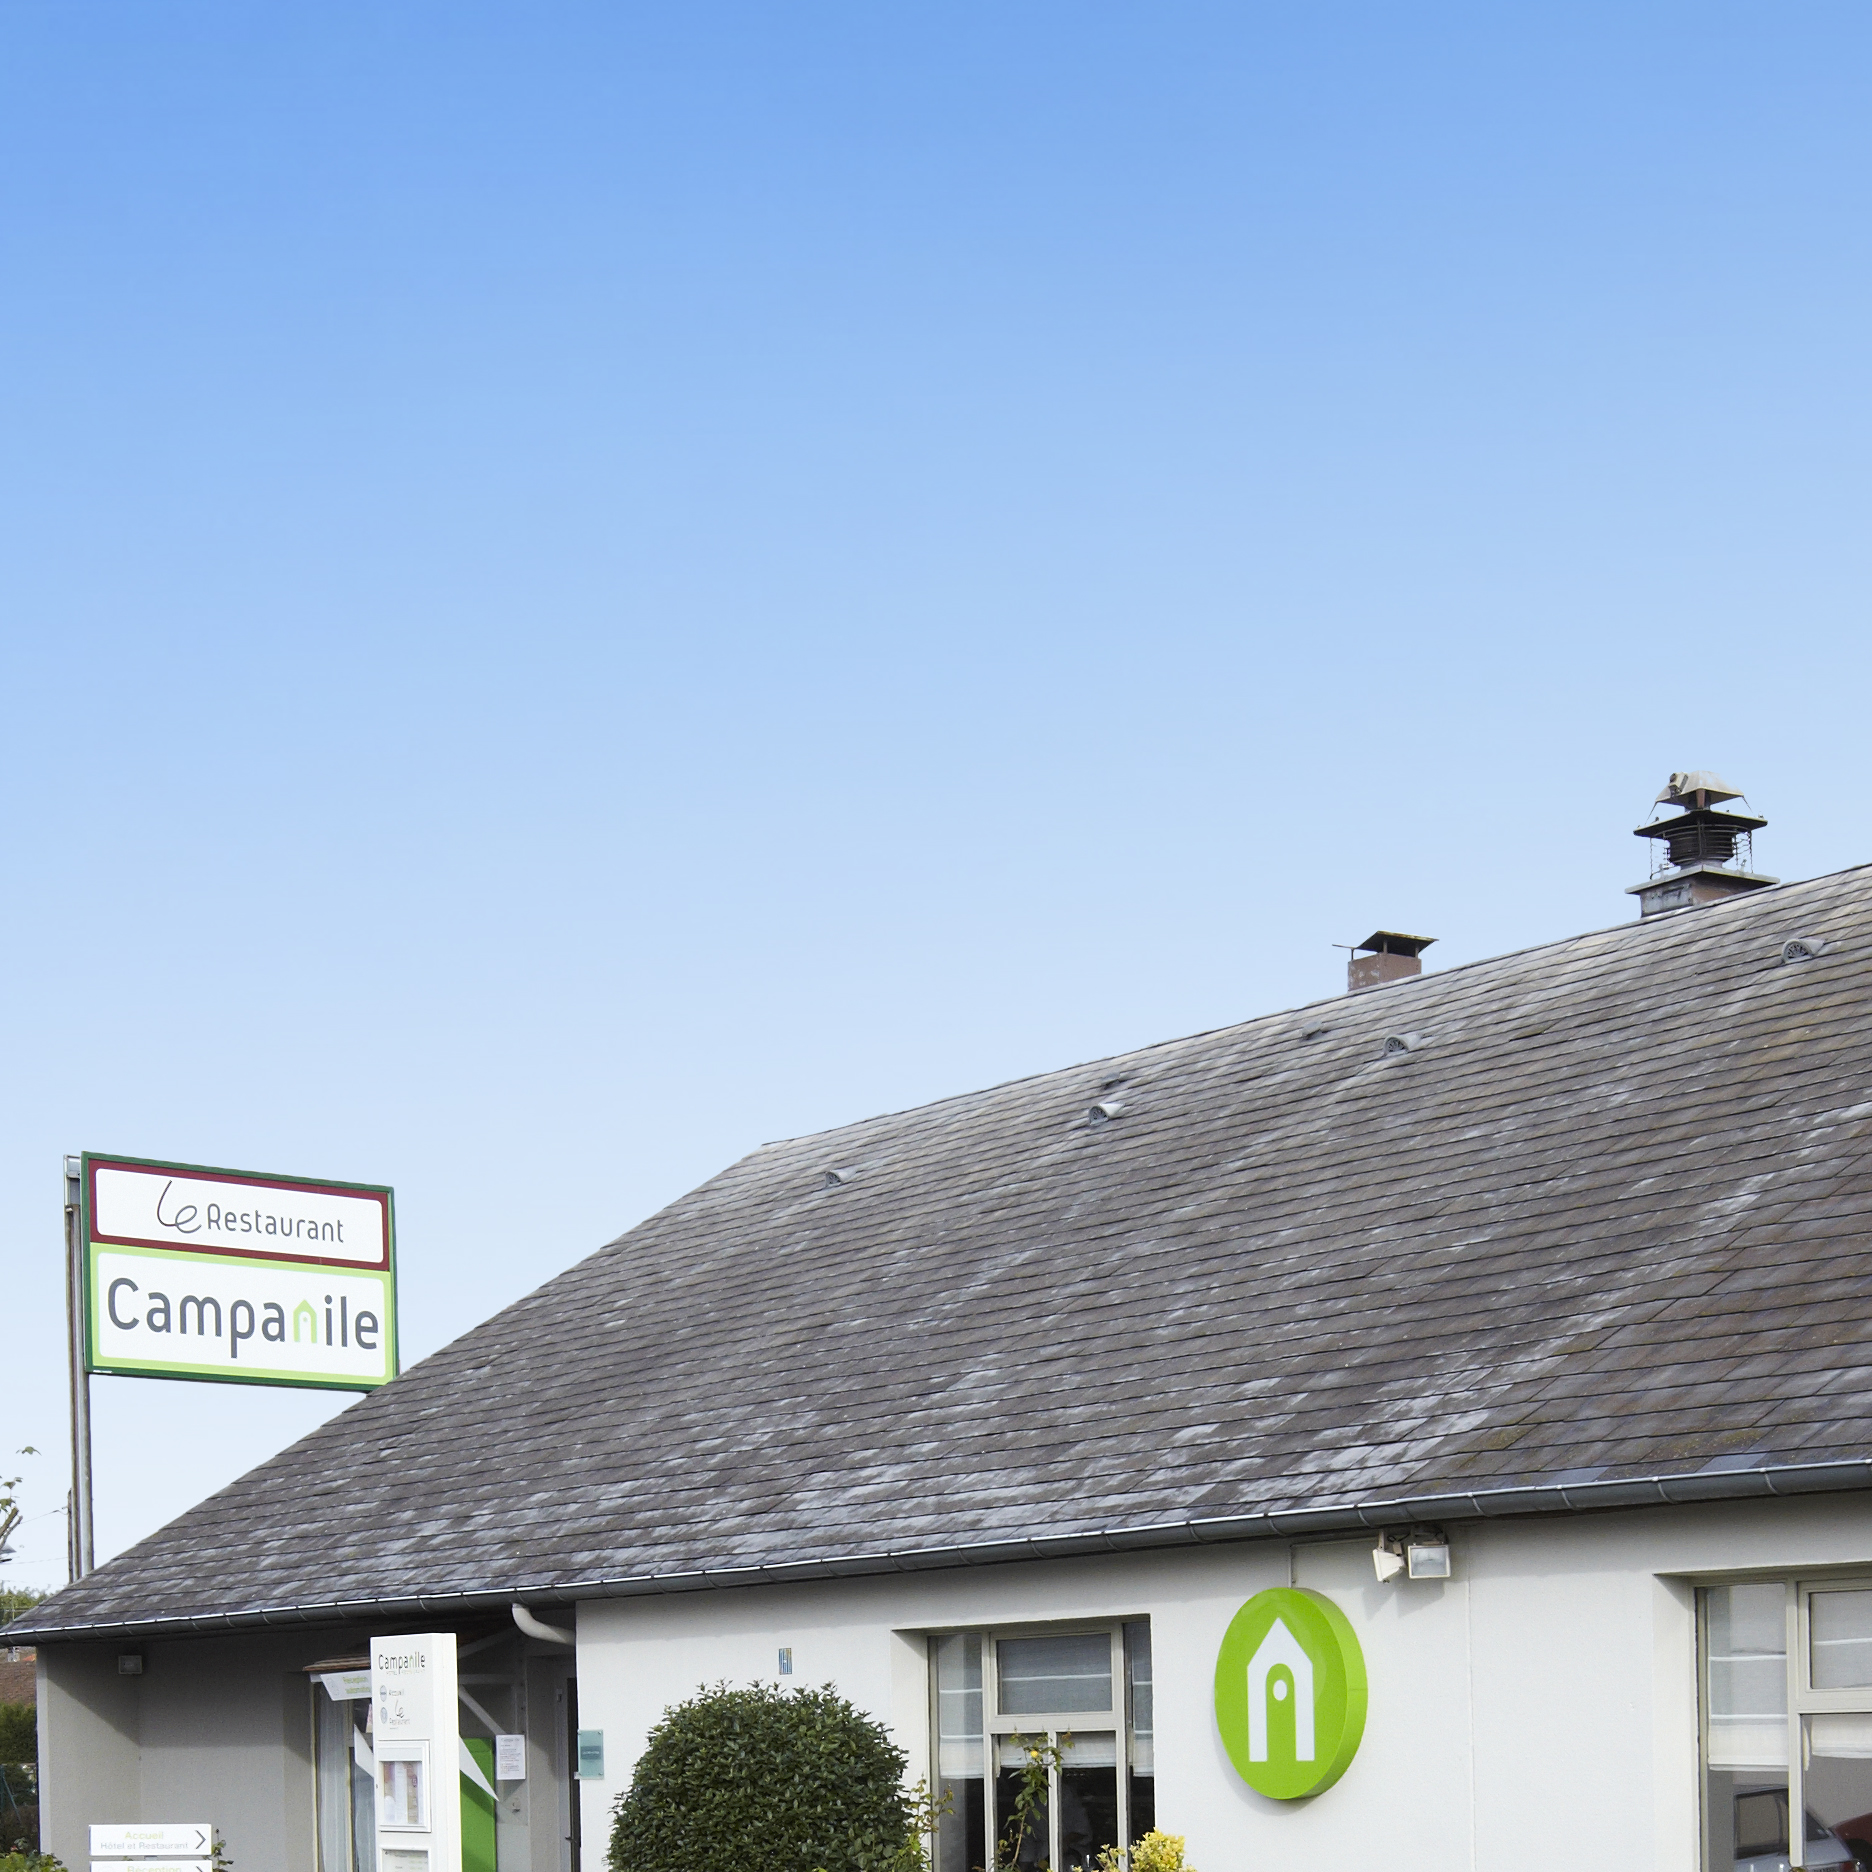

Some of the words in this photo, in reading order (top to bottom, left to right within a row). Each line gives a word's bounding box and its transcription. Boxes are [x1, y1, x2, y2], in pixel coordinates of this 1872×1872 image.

[156, 1179, 202, 1234] Le
[206, 1202, 345, 1244] Restaurant
[107, 1276, 380, 1359] Campanile
[378, 1651, 426, 1675] Campanile
[100, 1842, 125, 1850] Hôtel
[127, 1842, 136, 1850] et
[138, 1841, 189, 1850] Restaurant
[124, 1831, 164, 1840] Accueil
